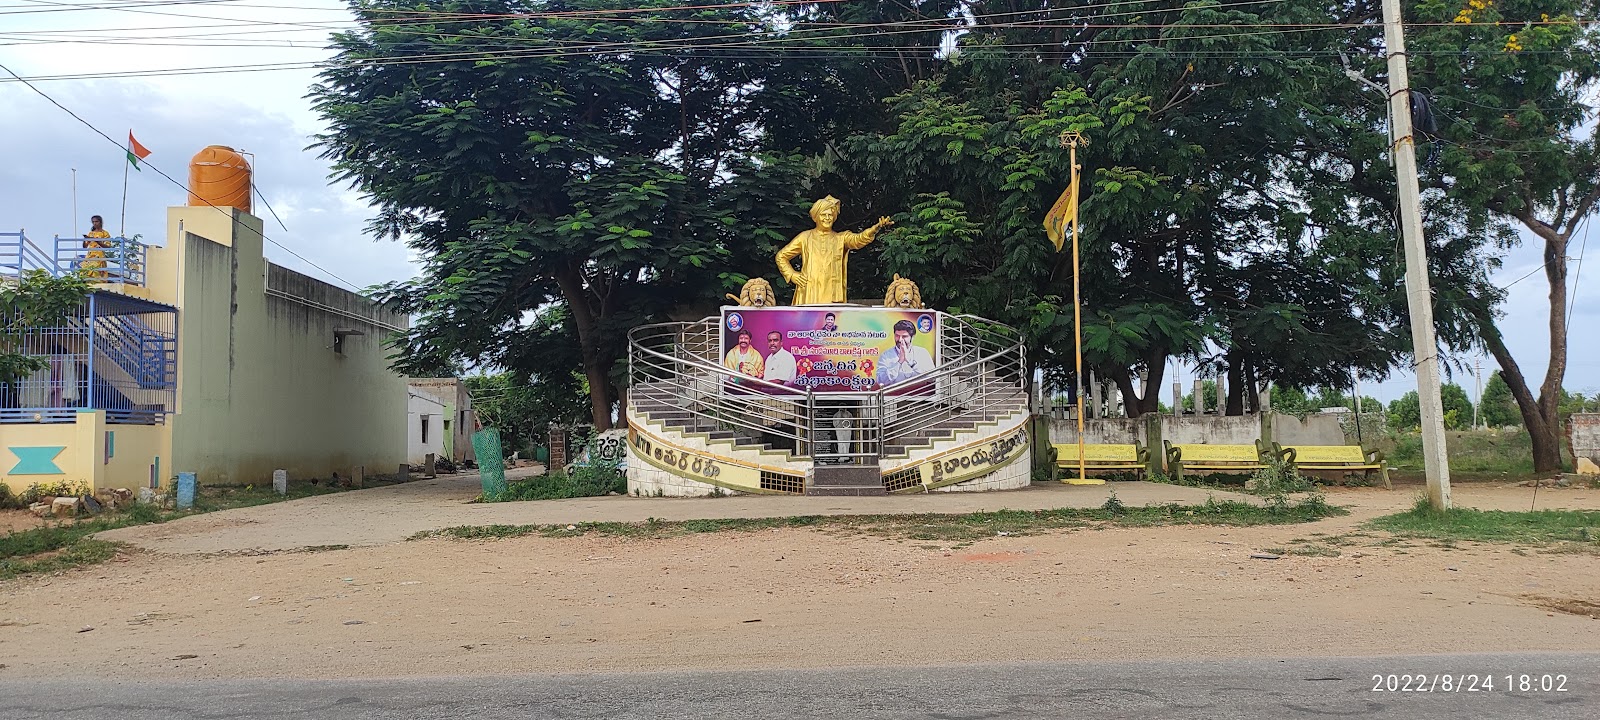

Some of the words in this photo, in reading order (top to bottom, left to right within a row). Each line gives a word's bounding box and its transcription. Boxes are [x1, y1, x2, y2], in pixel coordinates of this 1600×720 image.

[794, 375, 876, 391] శుభాకాంక్షలు
[654, 447, 690, 470] అమర్
[931, 460, 944, 483] జై
